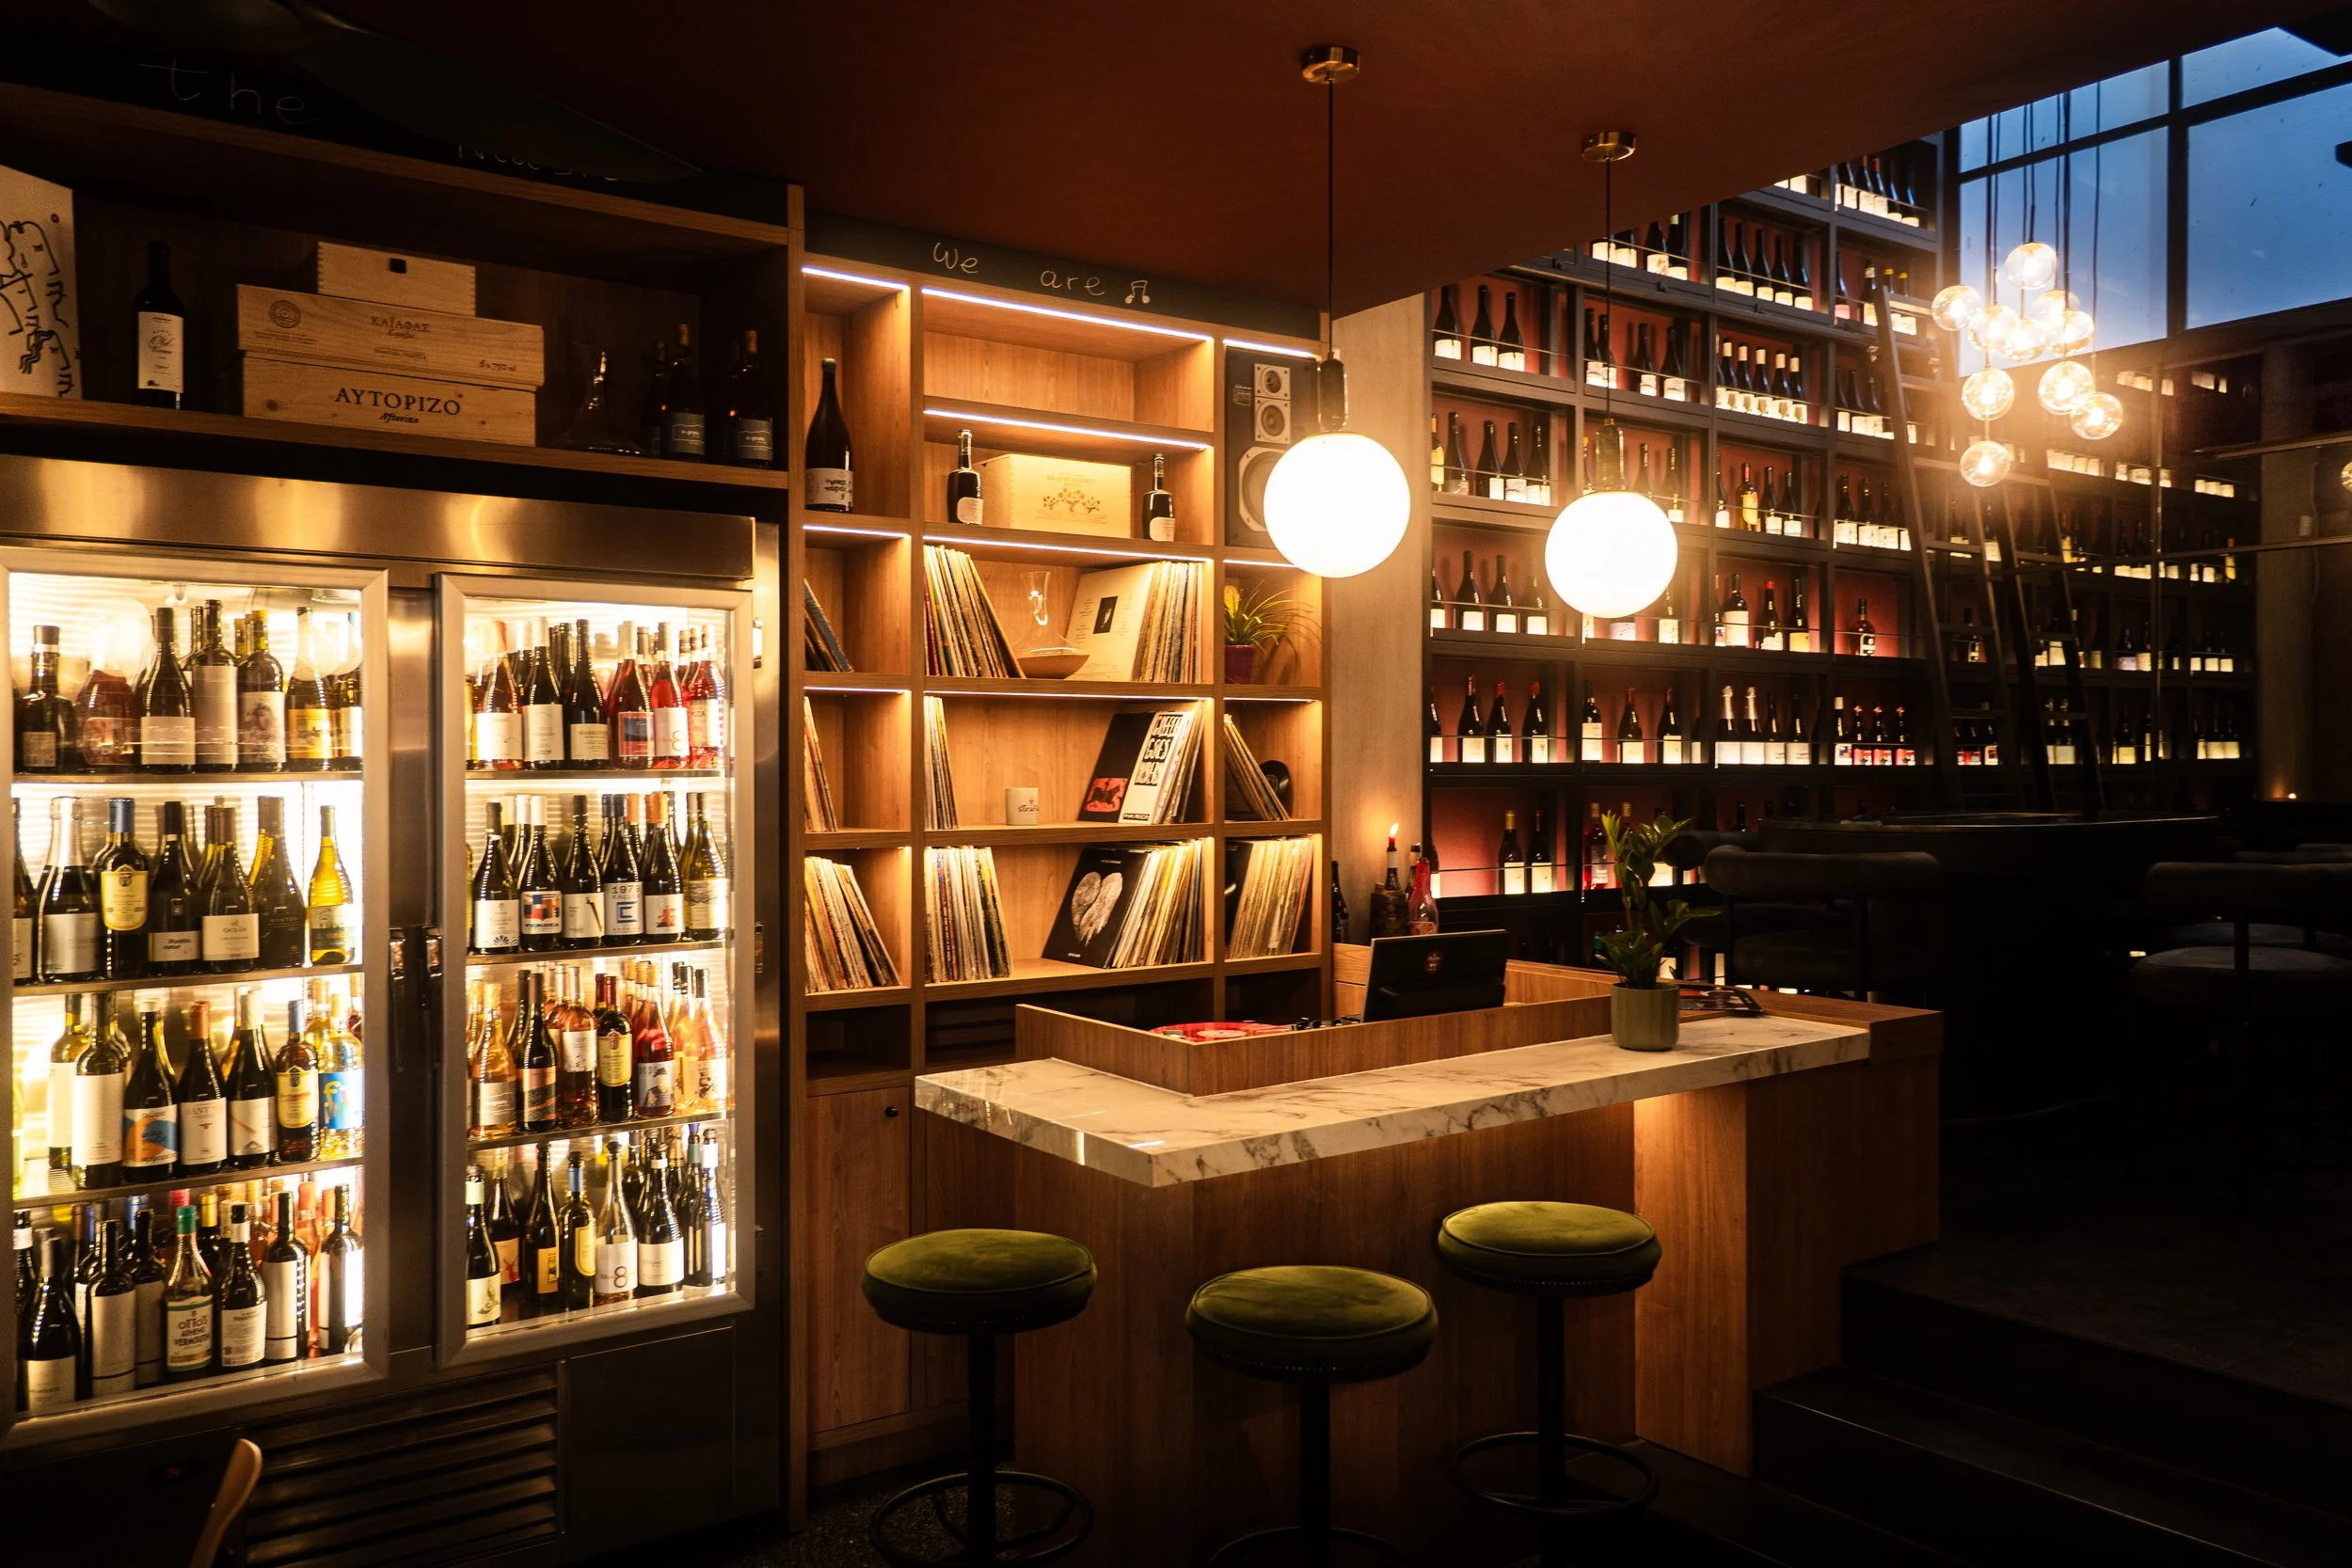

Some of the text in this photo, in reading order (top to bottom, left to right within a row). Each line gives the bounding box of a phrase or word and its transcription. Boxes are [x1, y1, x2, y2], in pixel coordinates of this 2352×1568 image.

[135, 57, 321, 126] the
[932, 242, 1104, 296] We are
